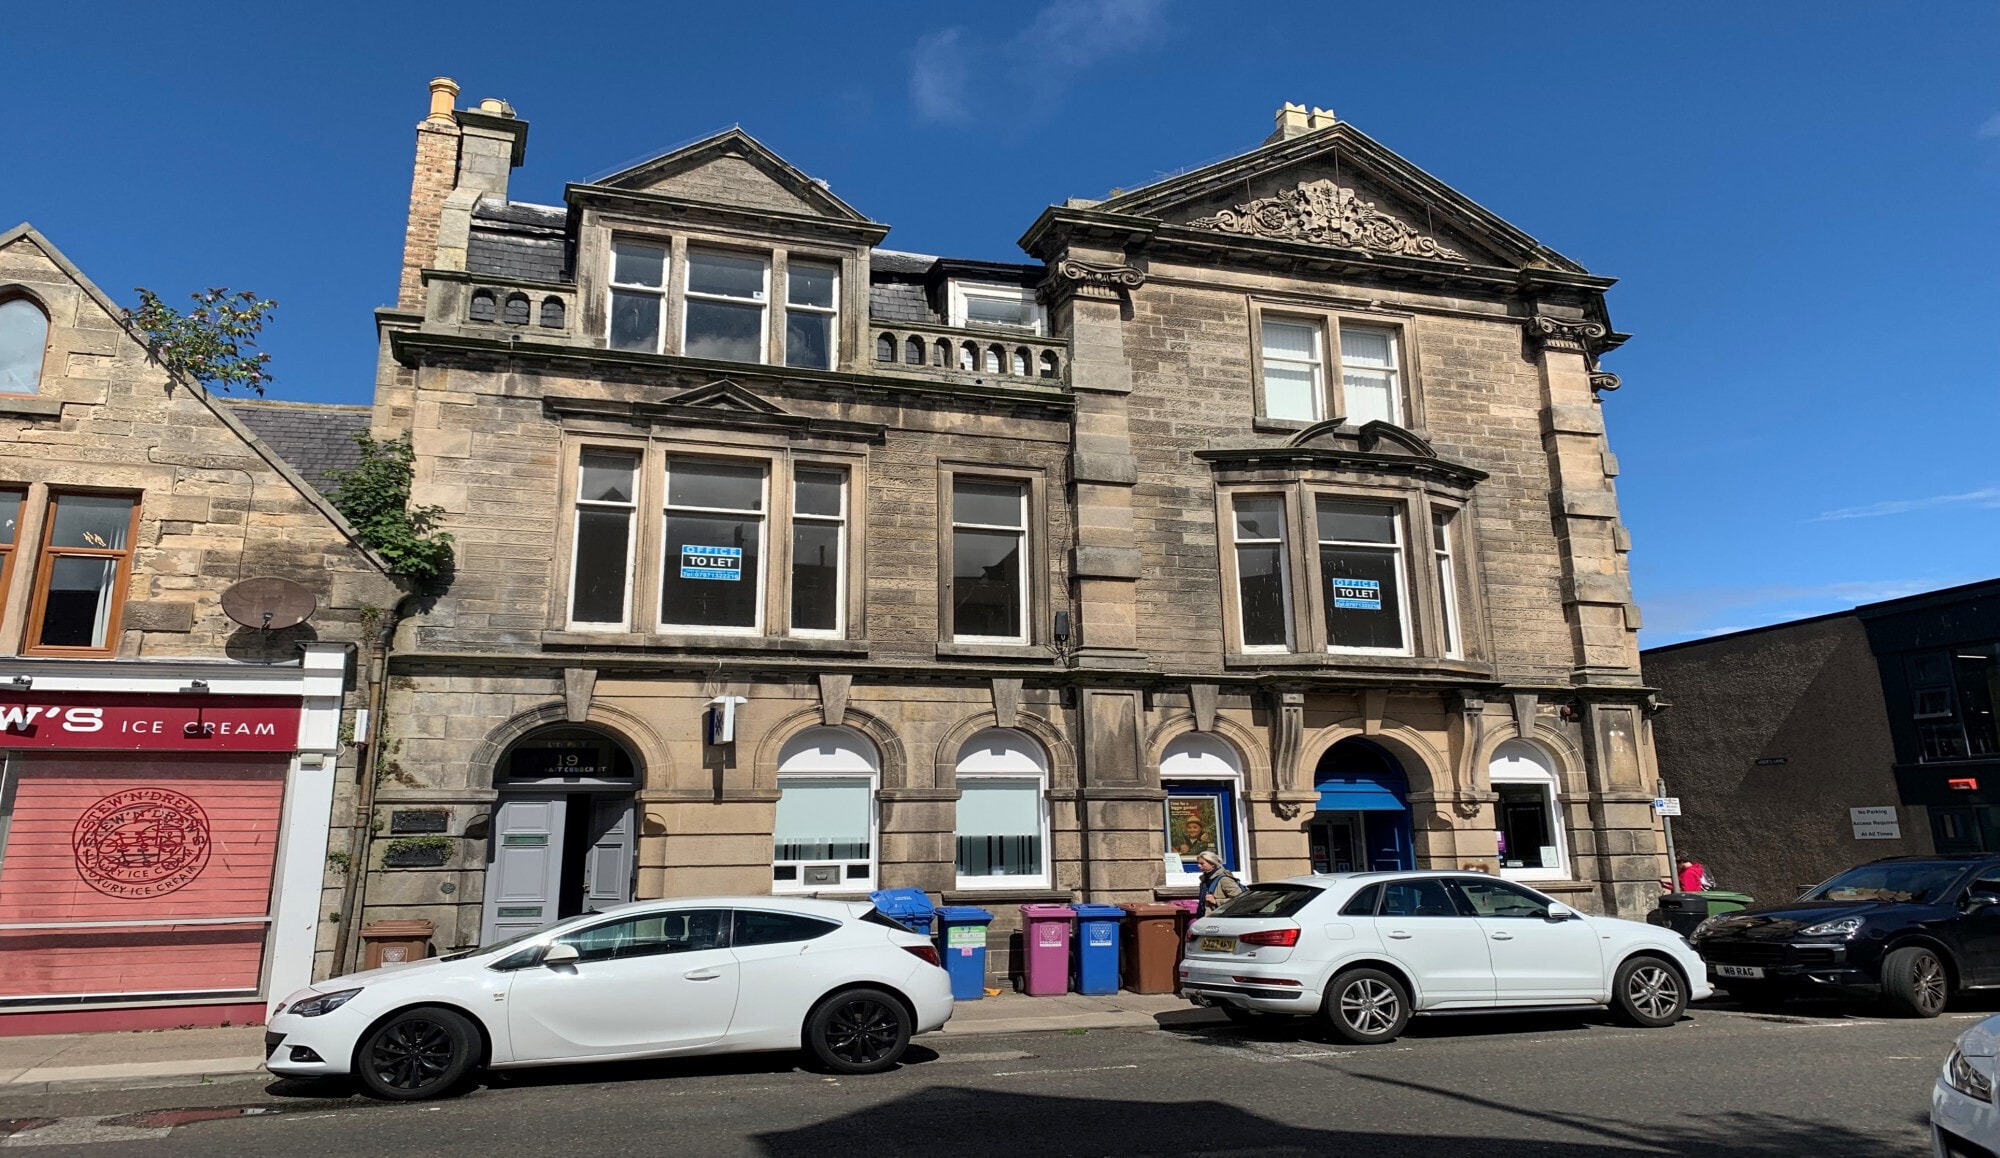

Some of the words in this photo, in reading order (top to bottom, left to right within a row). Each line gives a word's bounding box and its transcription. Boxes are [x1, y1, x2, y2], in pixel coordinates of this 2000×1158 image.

[686, 546, 737, 555] OFFICE
[689, 556, 707, 566] TO
[710, 557, 734, 567] LET
[1336, 579, 1377, 587] OFFICE
[1340, 588, 1354, 597] TO
[1356, 589, 1374, 598] LET
[122, 720, 164, 734] ICE
[183, 721, 275, 736] CREAM
[557, 754, 579, 766] 19
[128, 870, 149, 878] ICE
[130, 887, 151, 896] ICE
[1736, 967, 1755, 976] RAG
